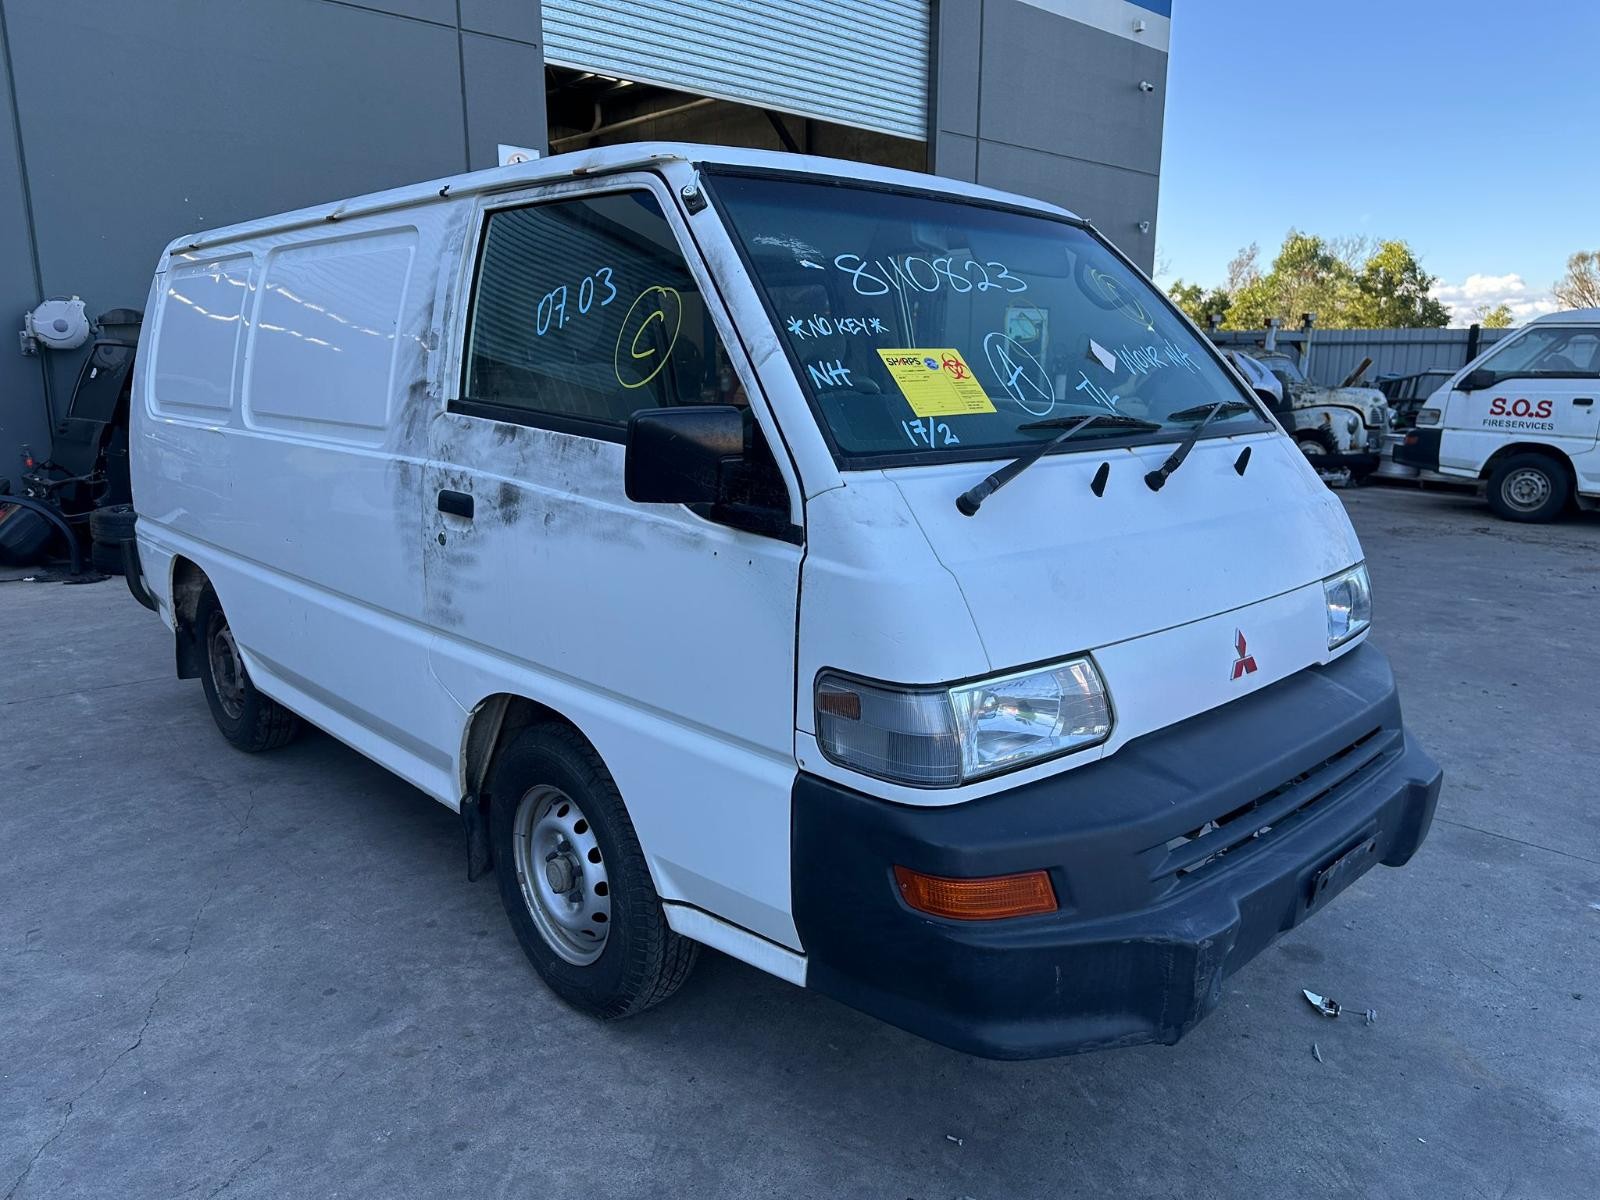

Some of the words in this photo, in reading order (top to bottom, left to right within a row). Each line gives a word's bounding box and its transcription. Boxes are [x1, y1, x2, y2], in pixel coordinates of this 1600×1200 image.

[807, 359, 853, 390] NH
[995, 344, 1051, 401] A
[1489, 397, 1553, 419] S.O.S
[901, 416, 961, 449] 17/2
